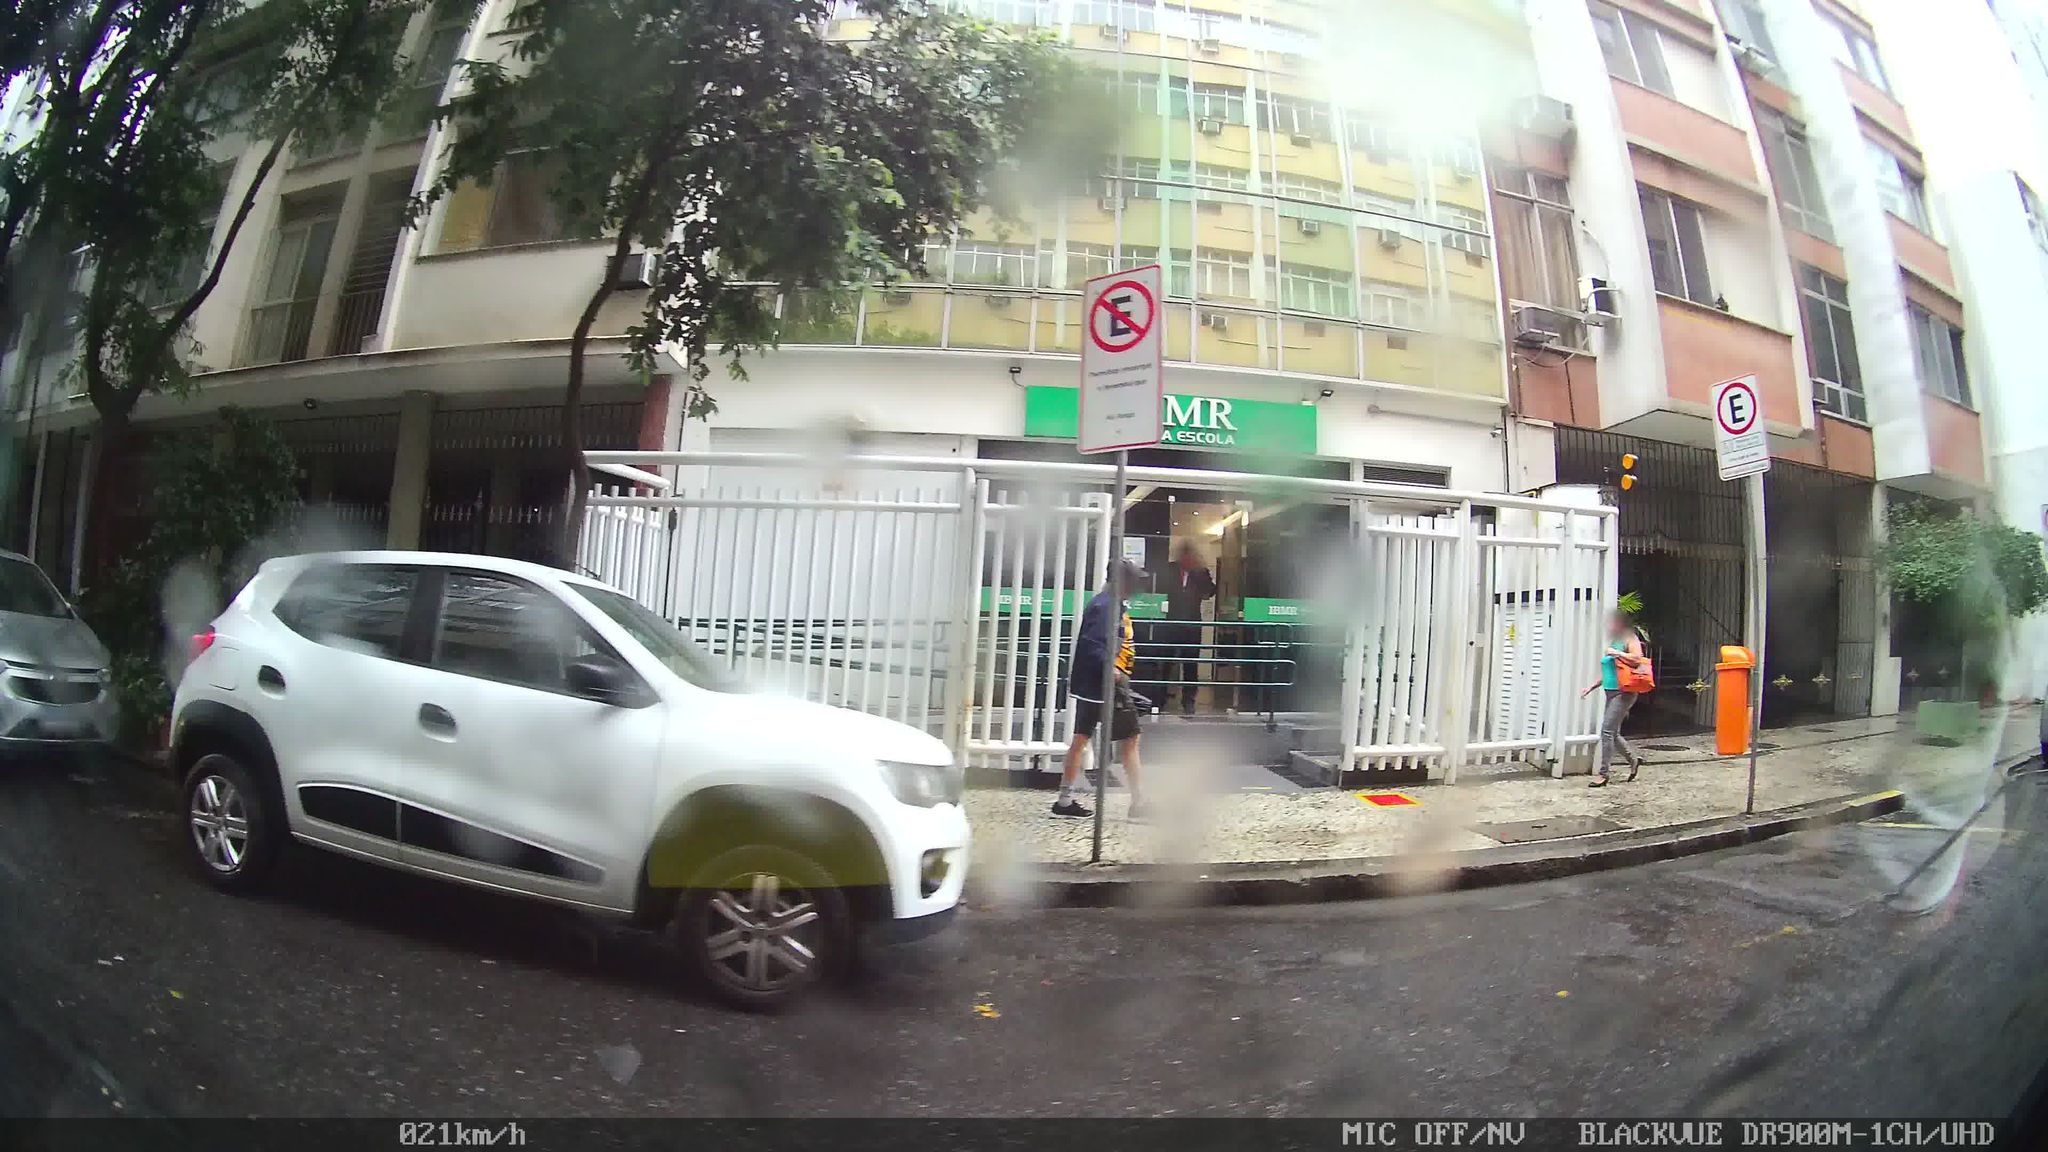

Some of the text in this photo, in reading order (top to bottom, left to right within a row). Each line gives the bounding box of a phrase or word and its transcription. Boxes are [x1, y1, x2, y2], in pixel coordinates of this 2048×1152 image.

[1110, 295, 1132, 338] E
[1728, 393, 1745, 424] E
[1176, 431, 1235, 444] ESCOLA
